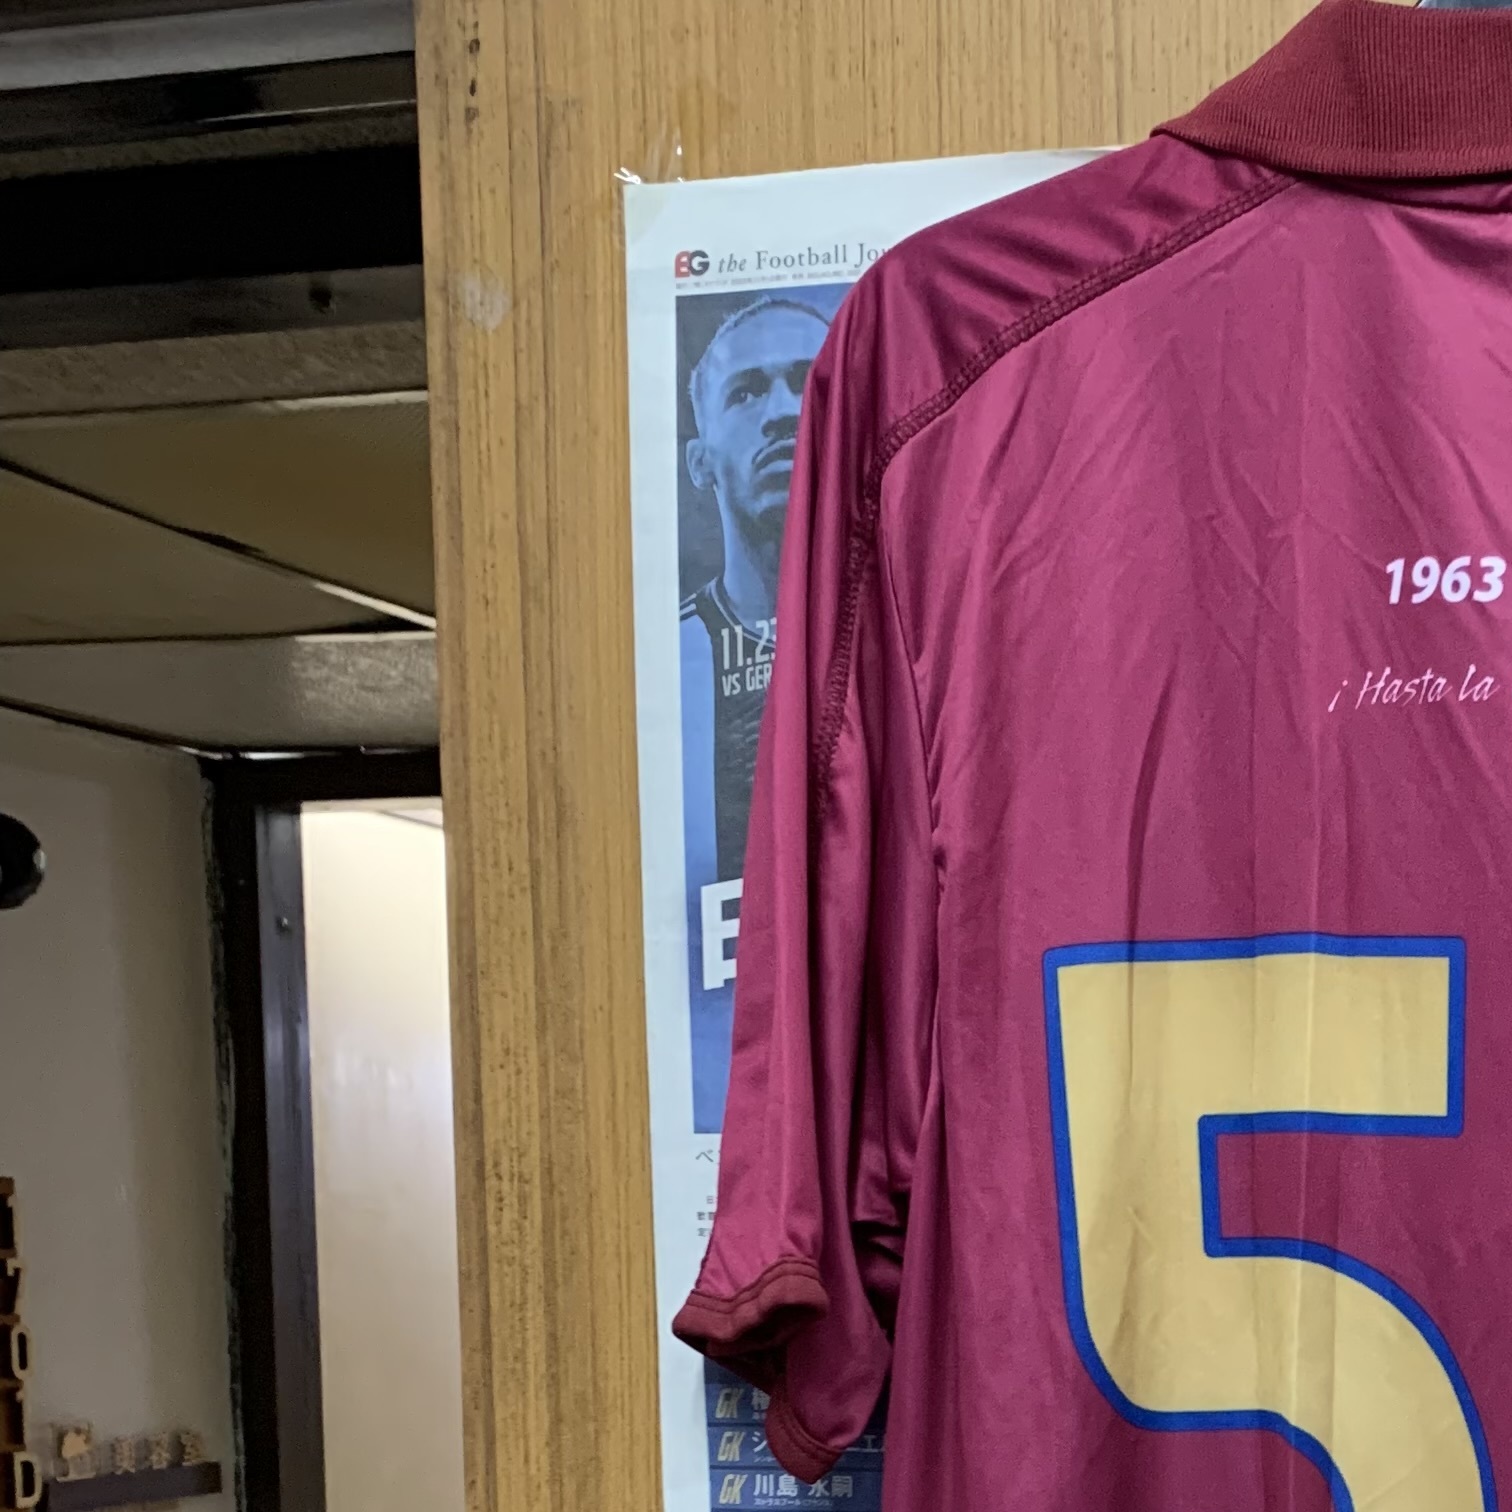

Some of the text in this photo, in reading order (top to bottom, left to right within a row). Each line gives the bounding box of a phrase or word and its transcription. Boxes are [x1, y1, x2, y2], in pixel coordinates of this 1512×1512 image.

[717, 253, 748, 273] the
[756, 245, 847, 270] Football
[1385, 556, 1507, 604] 1963
[722, 673, 741, 696] VS
[1457, 664, 1501, 701] la
[715, 1388, 744, 1419] GK
[717, 1431, 746, 1462] GK
[719, 1474, 748, 1504] GK
[753, 1474, 798, 1497] 川島
